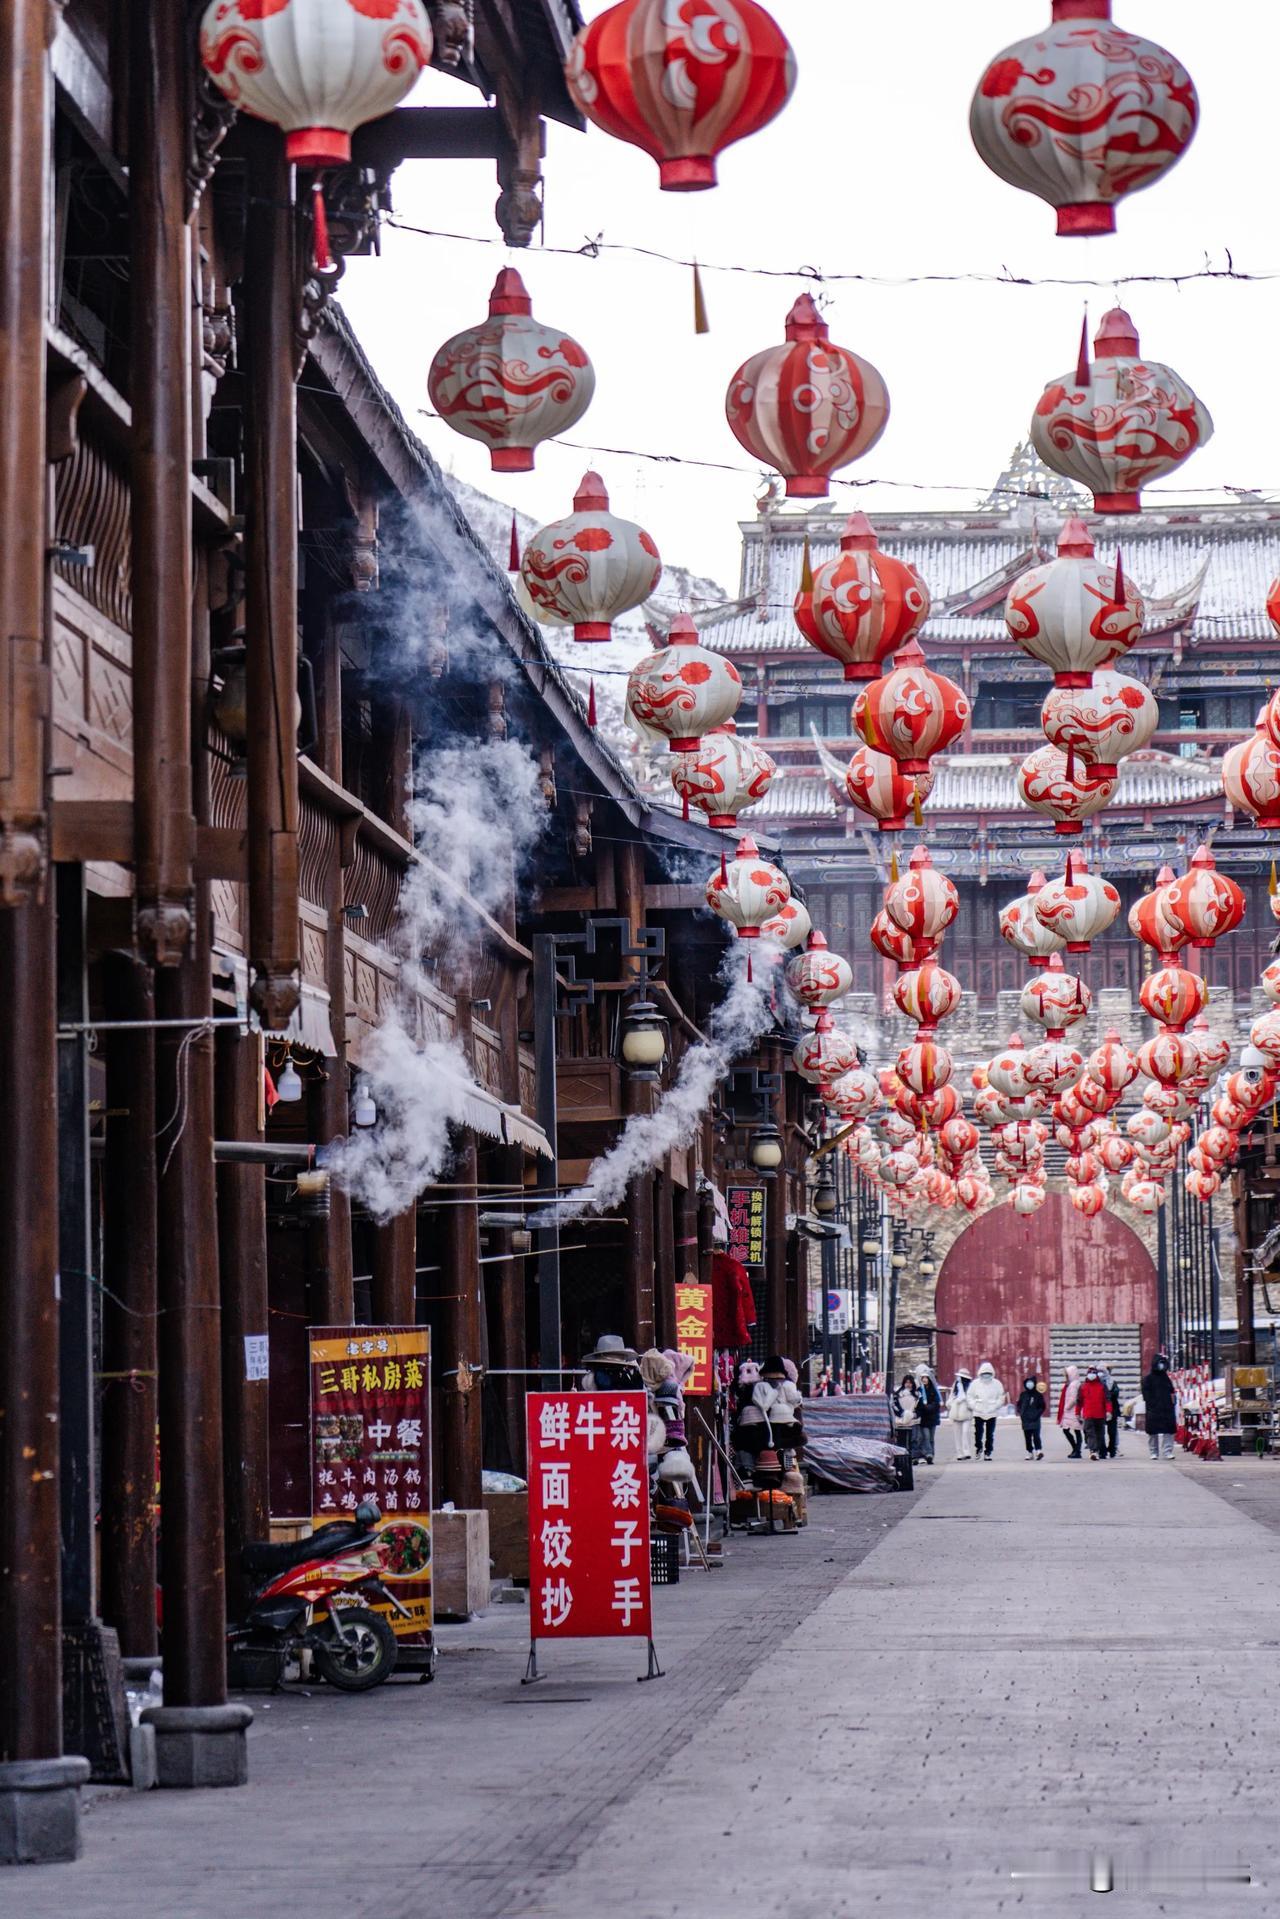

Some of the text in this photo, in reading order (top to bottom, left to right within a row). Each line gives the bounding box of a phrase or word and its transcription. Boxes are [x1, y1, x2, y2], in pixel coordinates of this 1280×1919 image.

[730, 1191, 750, 1263] 手机维修
[347, 1340, 388, 1355] 老字号
[320, 1358, 423, 1394] 三哥私房菜
[367, 1418, 423, 1448] 中餐
[539, 1401, 641, 1451] 鲜牛杂
[318, 1467, 421, 1487] 牦牛肉汤锅
